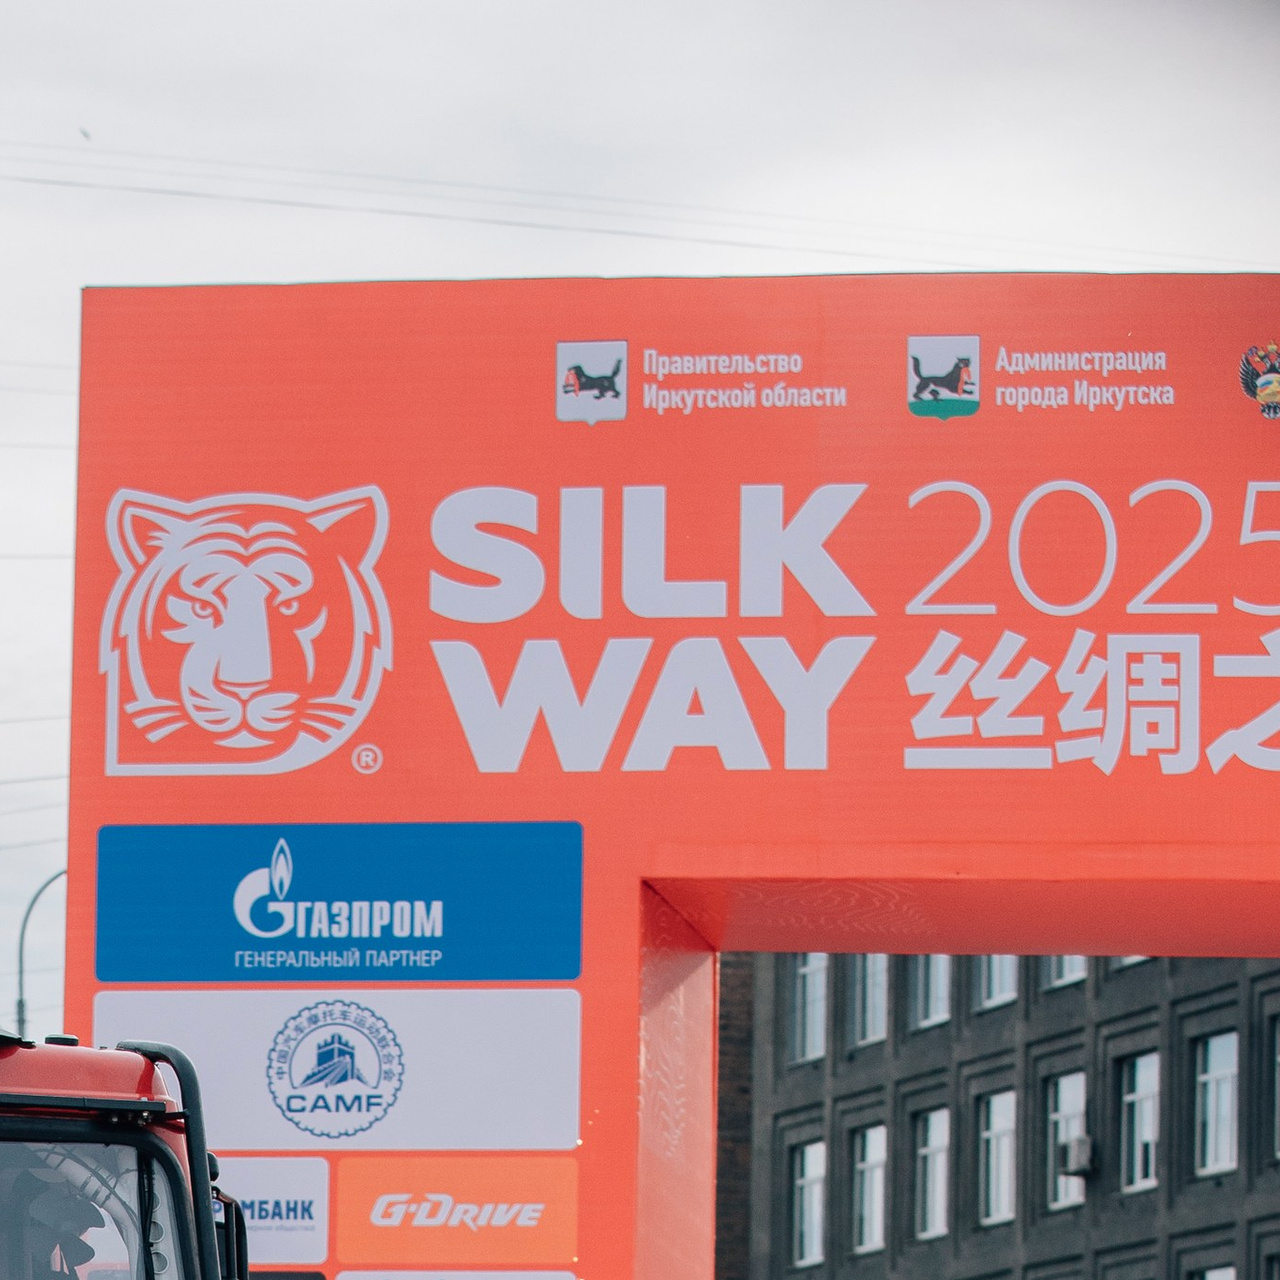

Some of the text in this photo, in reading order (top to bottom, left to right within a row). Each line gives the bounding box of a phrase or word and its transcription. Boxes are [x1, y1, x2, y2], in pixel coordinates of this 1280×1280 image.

[642, 347, 803, 379] Правительство
[995, 345, 1167, 377] Администрация
[643, 381, 848, 414] Иркутской области
[995, 380, 1176, 413] города Иркутска
[429, 479, 1280, 624] SILK 2025
[429, 636, 878, 773] WAY
[296, 900, 443, 938] ГАЗПРОМ
[235, 948, 443, 968] ГЕНЕРАЛЬНЫЙ ПАРТНЕР
[286, 1094, 383, 1113] CAMF
